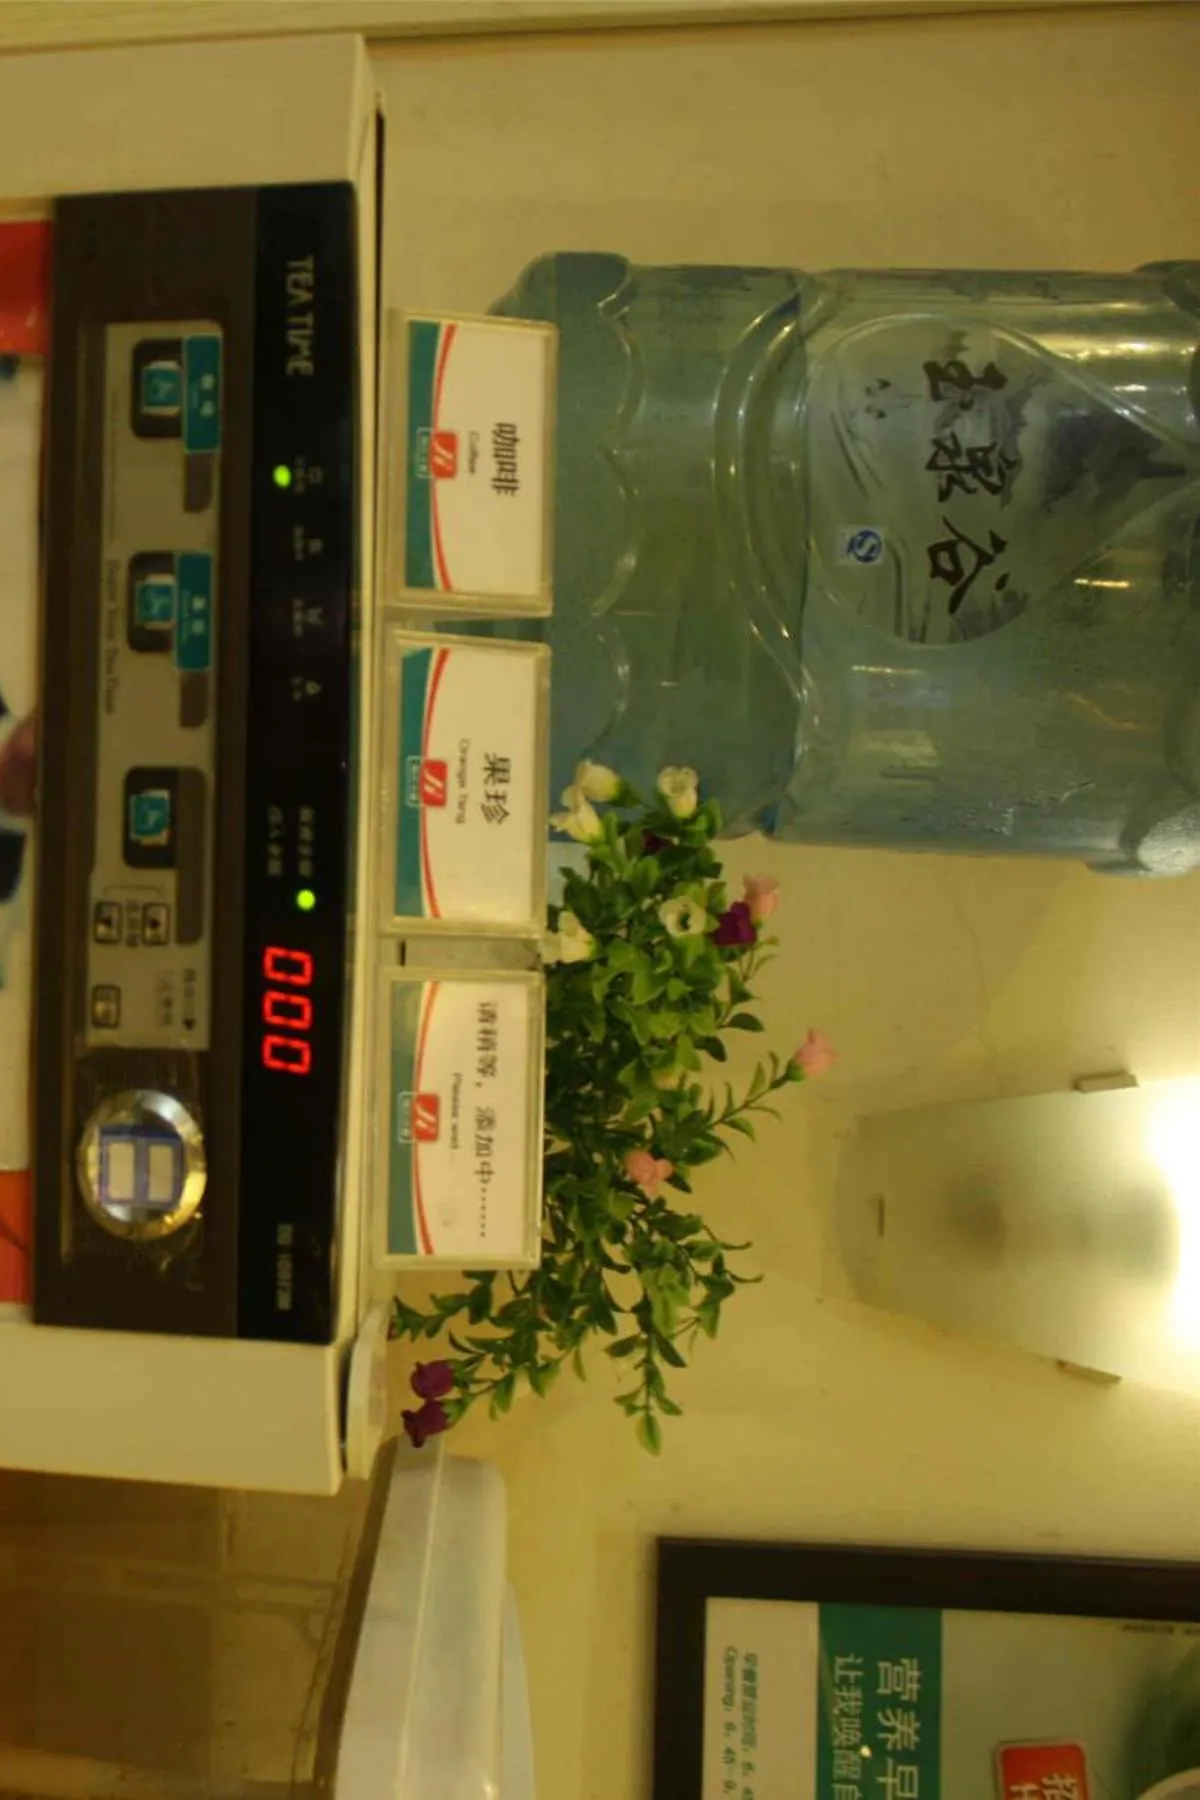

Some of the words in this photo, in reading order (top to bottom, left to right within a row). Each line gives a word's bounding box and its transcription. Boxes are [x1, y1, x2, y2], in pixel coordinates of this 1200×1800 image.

[284, 254, 315, 307] TEA
[284, 310, 315, 378] TIME
[467, 431, 480, 475] Coffee
[491, 422, 521, 497] 咖啡
[480, 752, 512, 826] 果珍
[262, 946, 314, 1075] 000
